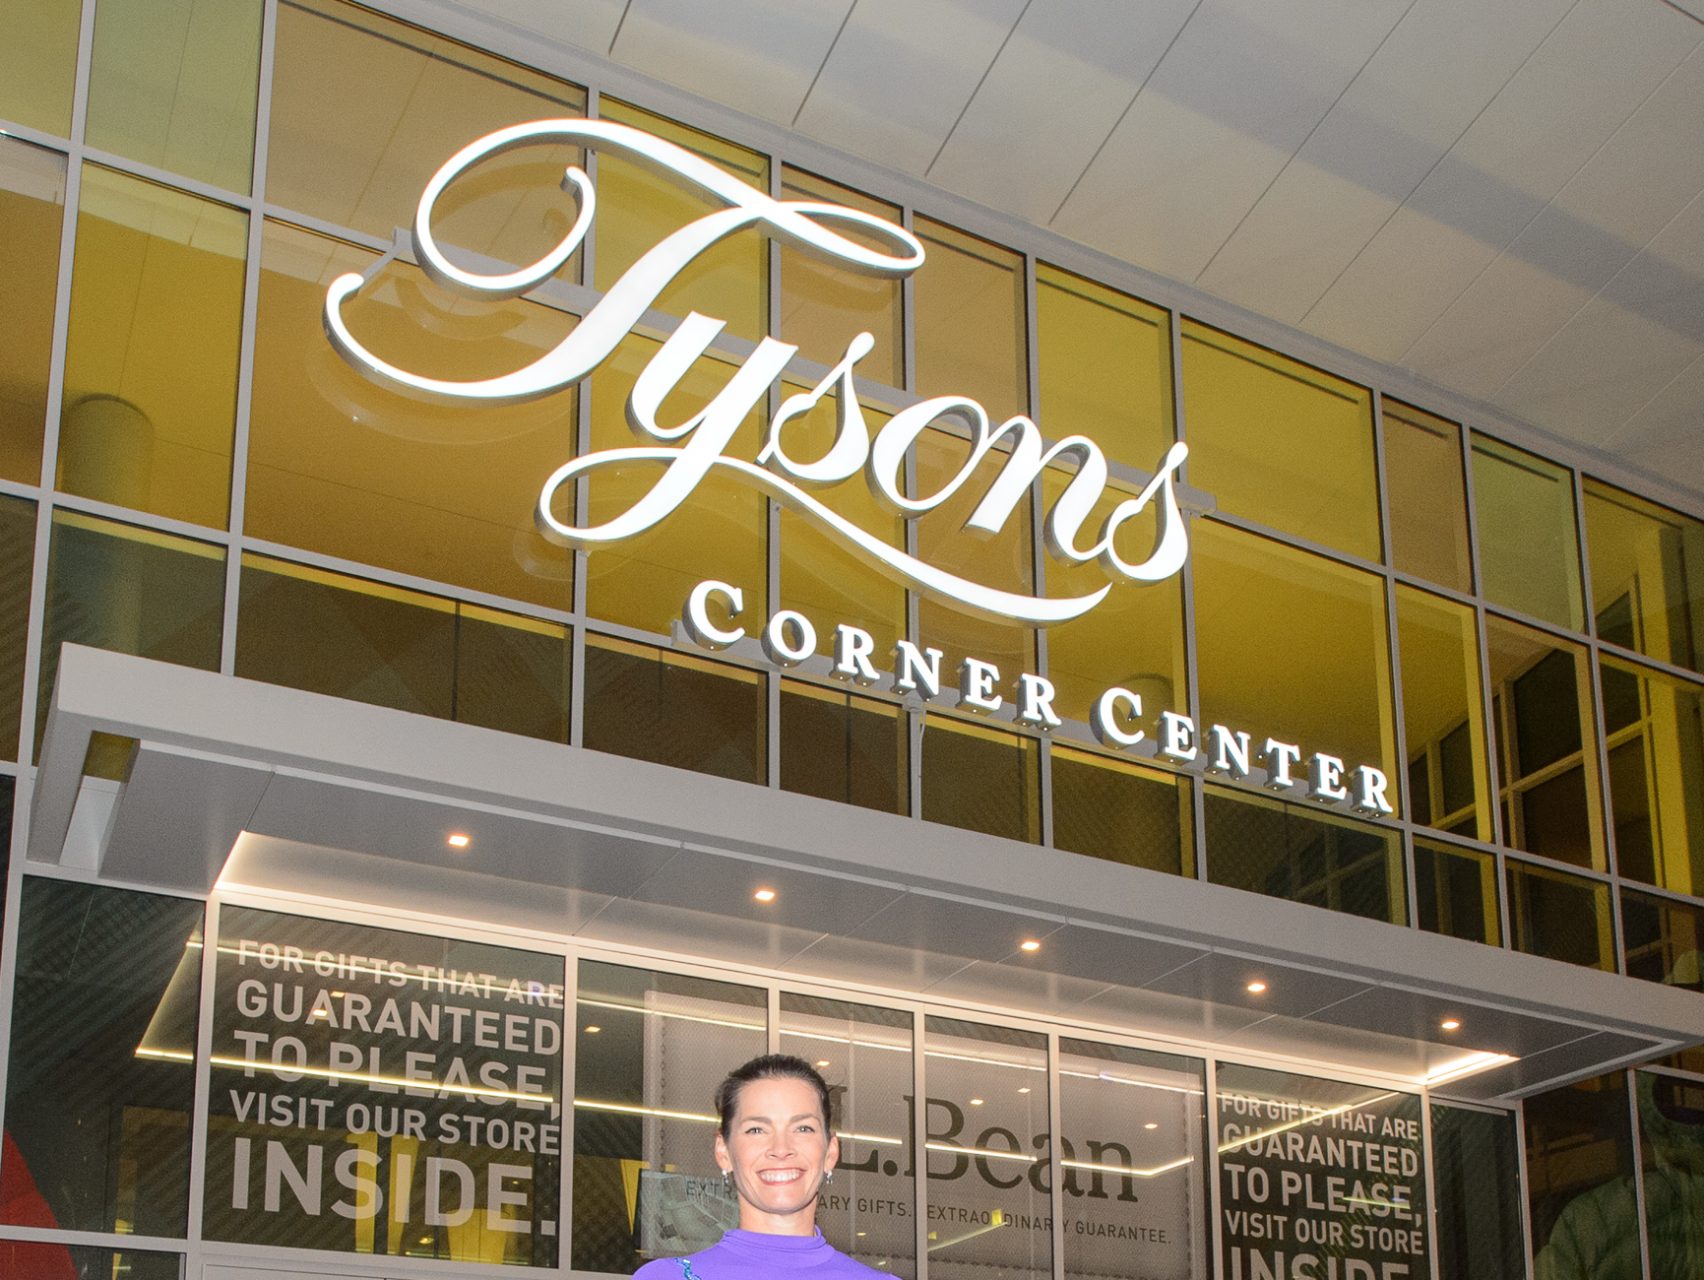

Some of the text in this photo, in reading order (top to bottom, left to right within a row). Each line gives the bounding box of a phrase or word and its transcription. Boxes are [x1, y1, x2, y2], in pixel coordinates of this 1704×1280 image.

[326, 117, 1190, 624] Tysons
[683, 580, 1393, 817] CORNER CENTER
[238, 940, 564, 1010] FOR GIFTS THAT ARE
[237, 980, 561, 1056] GUARANTEED
[234, 1030, 561, 1121] TO PLEASE,
[230, 1090, 560, 1155] VISIT OUR STORE
[1222, 1093, 1418, 1141] FOR GIFTS THAT ARE
[1222, 1124, 1418, 1177] GUARANTEED
[232, 1138, 556, 1236] INSIDE.
[1224, 1163, 1422, 1228] TO PLEASE,
[857, 1199, 912, 1218] GIFTS.
[1075, 1221, 1172, 1244] GUARANTEE.
[1225, 1210, 1424, 1255] VISIT OUR STORE
